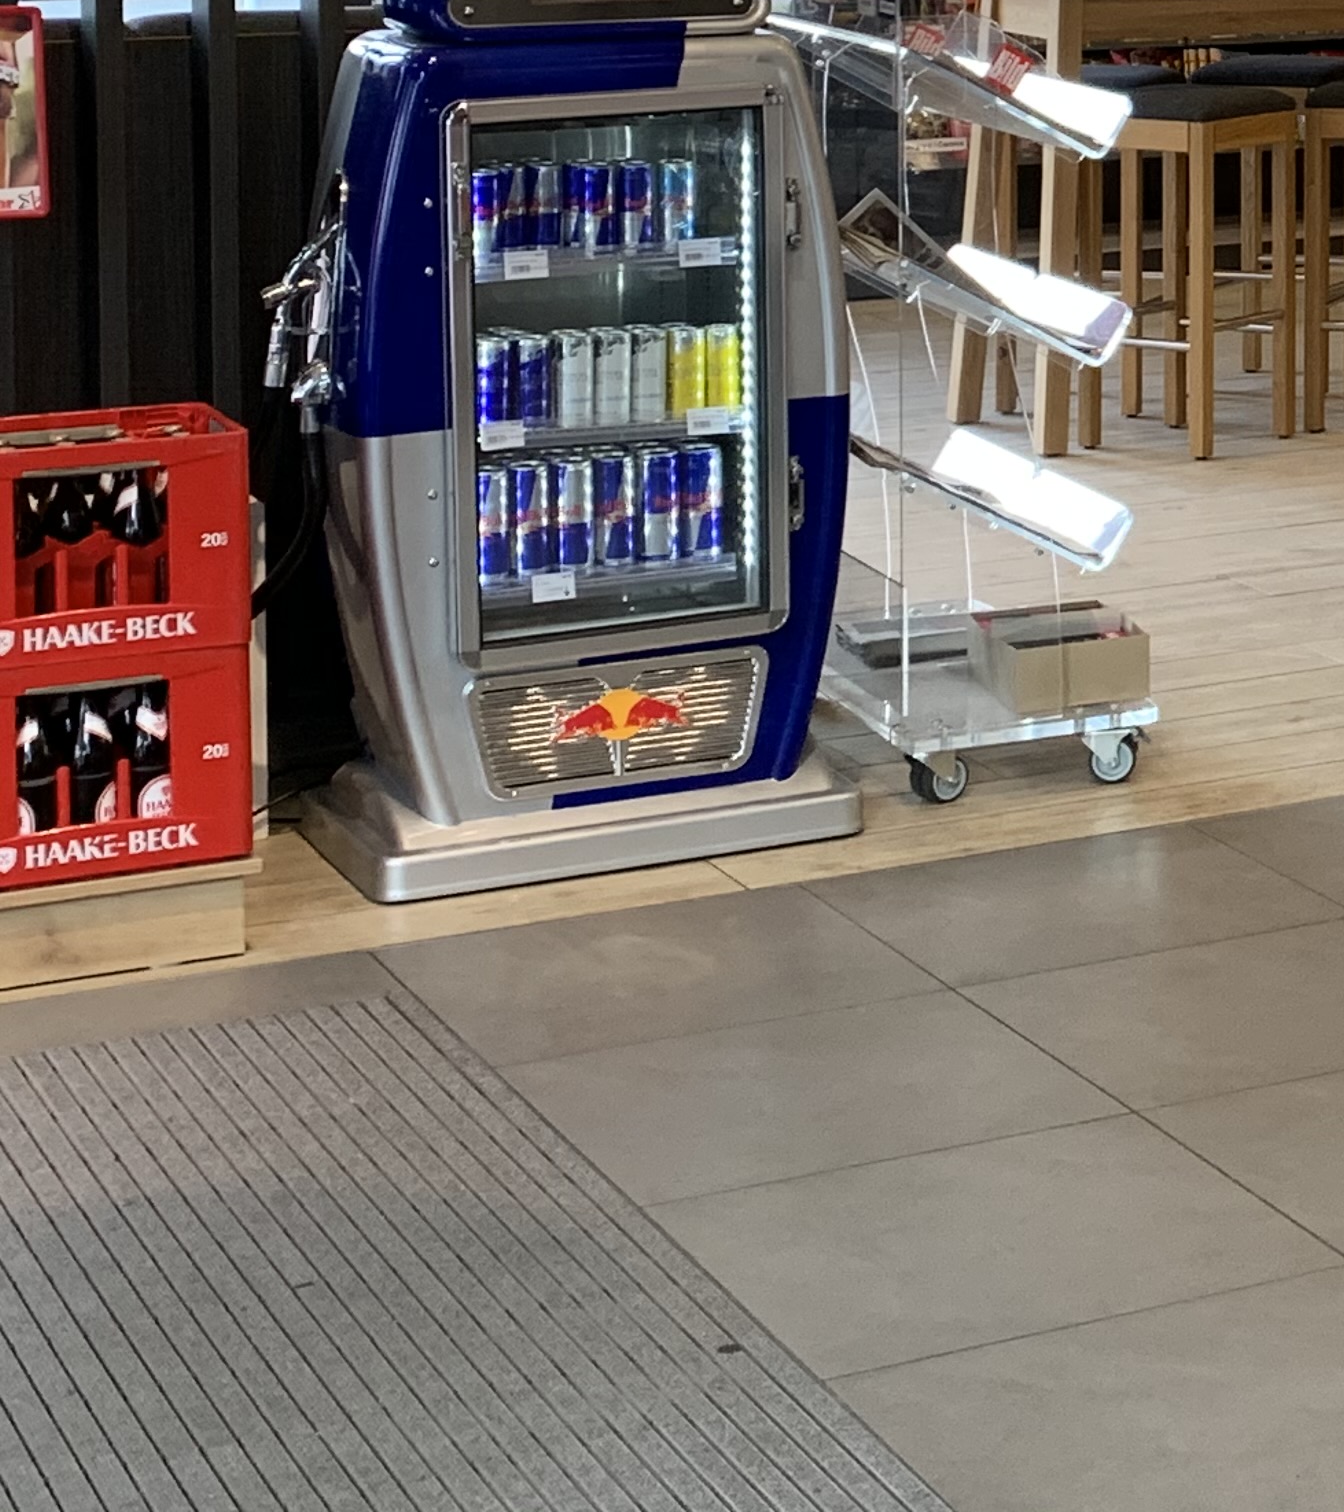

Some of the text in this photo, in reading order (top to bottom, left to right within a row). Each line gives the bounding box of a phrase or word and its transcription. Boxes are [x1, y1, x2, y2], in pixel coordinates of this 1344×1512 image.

[200, 532, 221, 548] 20
[22, 610, 198, 653] HAAKE-BECK
[202, 744, 222, 760] 20
[24, 822, 200, 870] HAAKE-BECK
